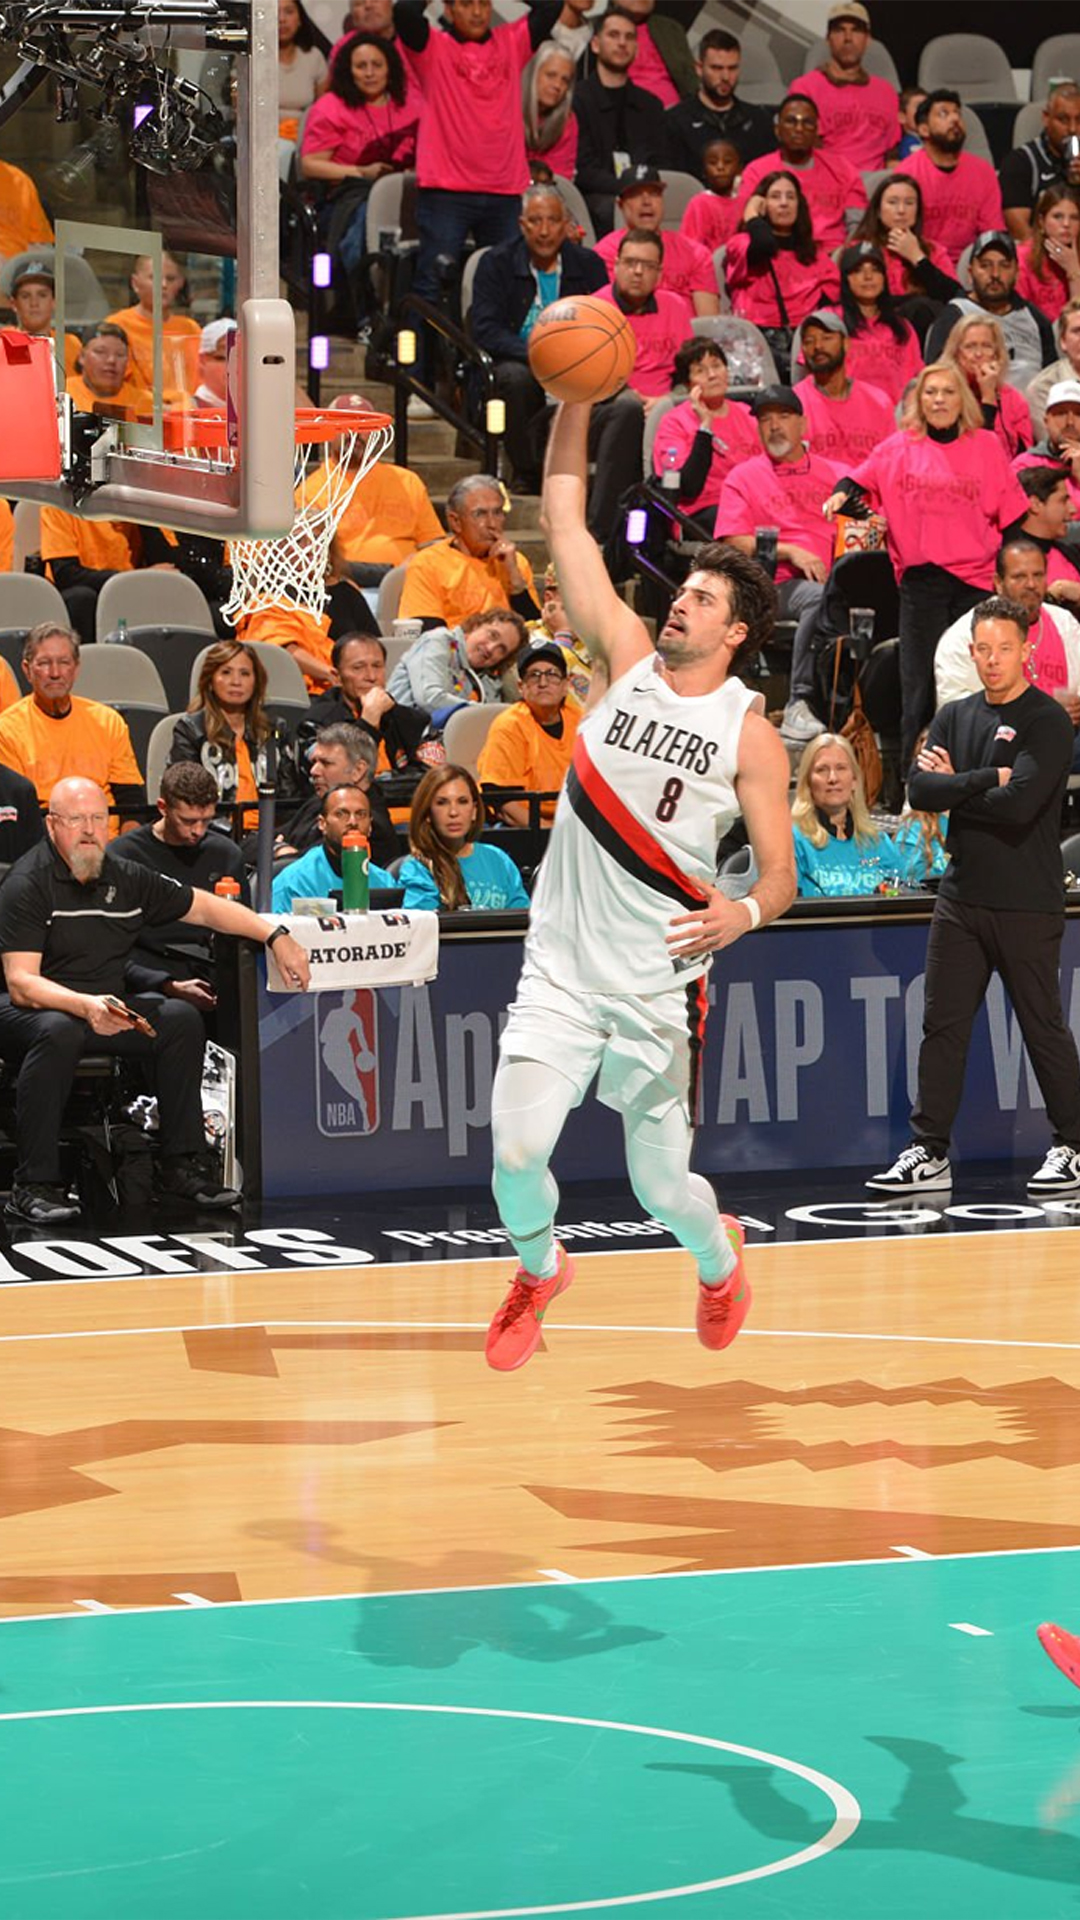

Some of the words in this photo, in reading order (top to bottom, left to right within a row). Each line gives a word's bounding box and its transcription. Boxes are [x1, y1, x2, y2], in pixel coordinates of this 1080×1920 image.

[603, 708, 719, 776] BLAZERS
[655, 776, 684, 823] 8
[309, 942, 407, 964] ATORADE
[392, 984, 508, 1157] Ap
[326, 1102, 356, 1127] NBA
[0, 1228, 375, 1282] OFFS
[381, 1218, 674, 1247] Presnte
[738, 1216, 775, 1232] y
